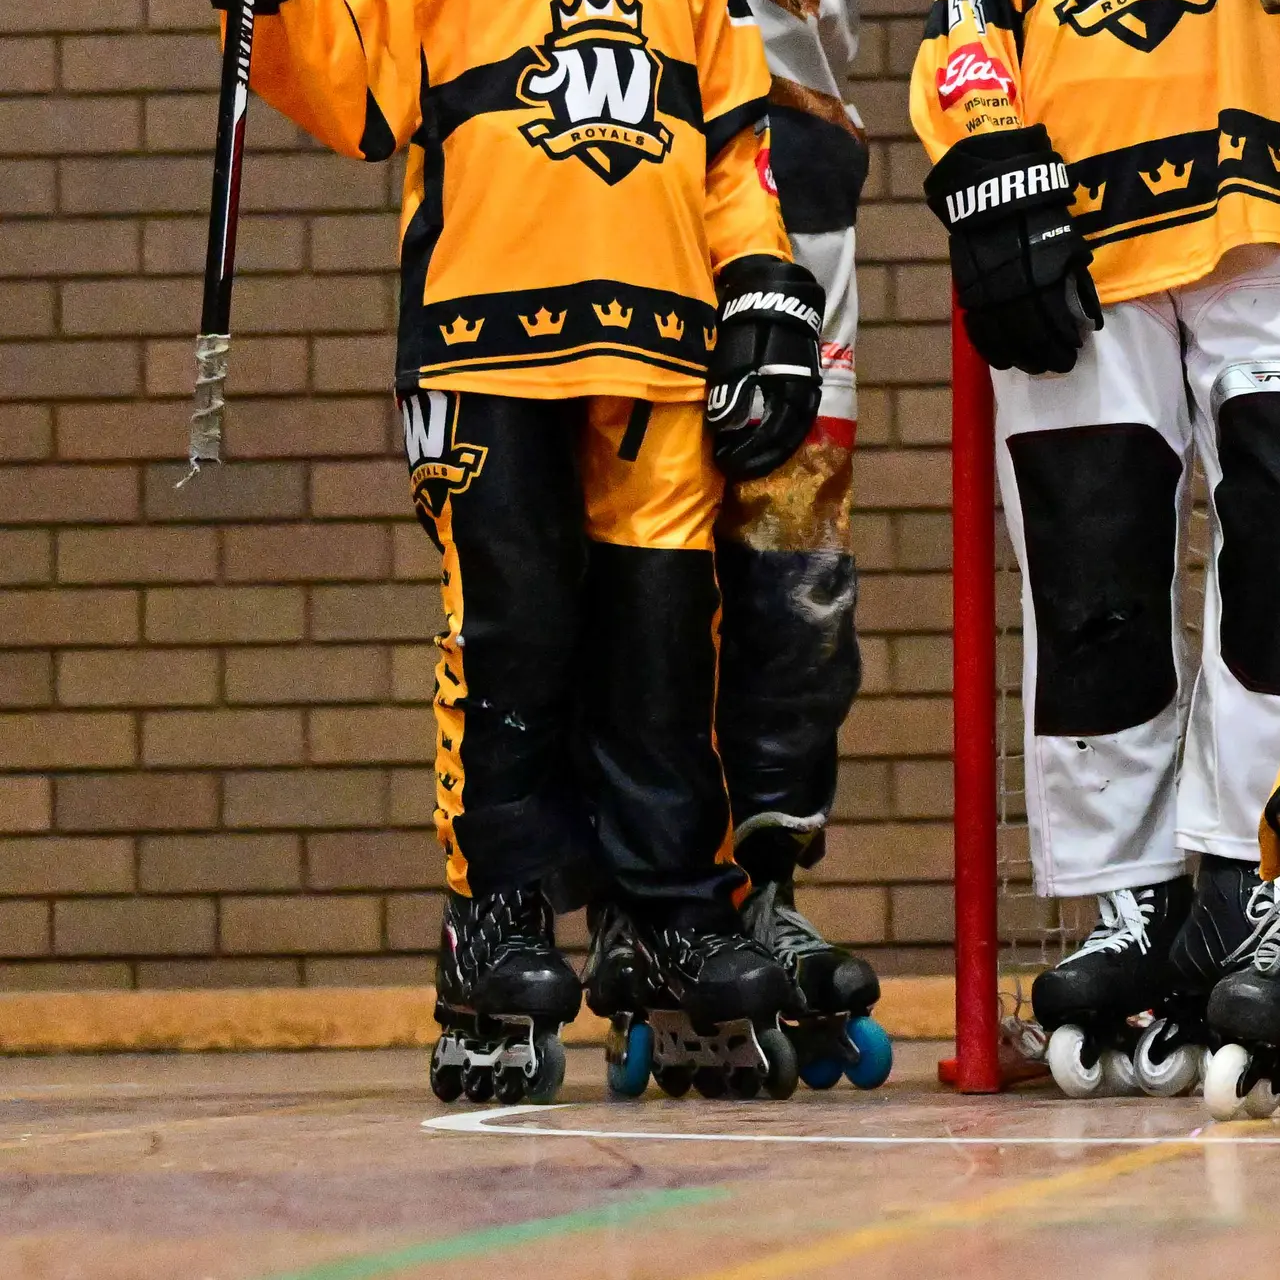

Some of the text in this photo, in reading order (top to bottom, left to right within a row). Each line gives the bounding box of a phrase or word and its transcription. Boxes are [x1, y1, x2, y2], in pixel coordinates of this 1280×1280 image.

[529, 46, 652, 125] W
[964, 95, 1014, 113] Insuran
[570, 127, 645, 147] ROYALS
[945, 161, 1070, 224] WARRIO
[1041, 224, 1072, 241] RISE
[721, 291, 823, 333] WINNWE
